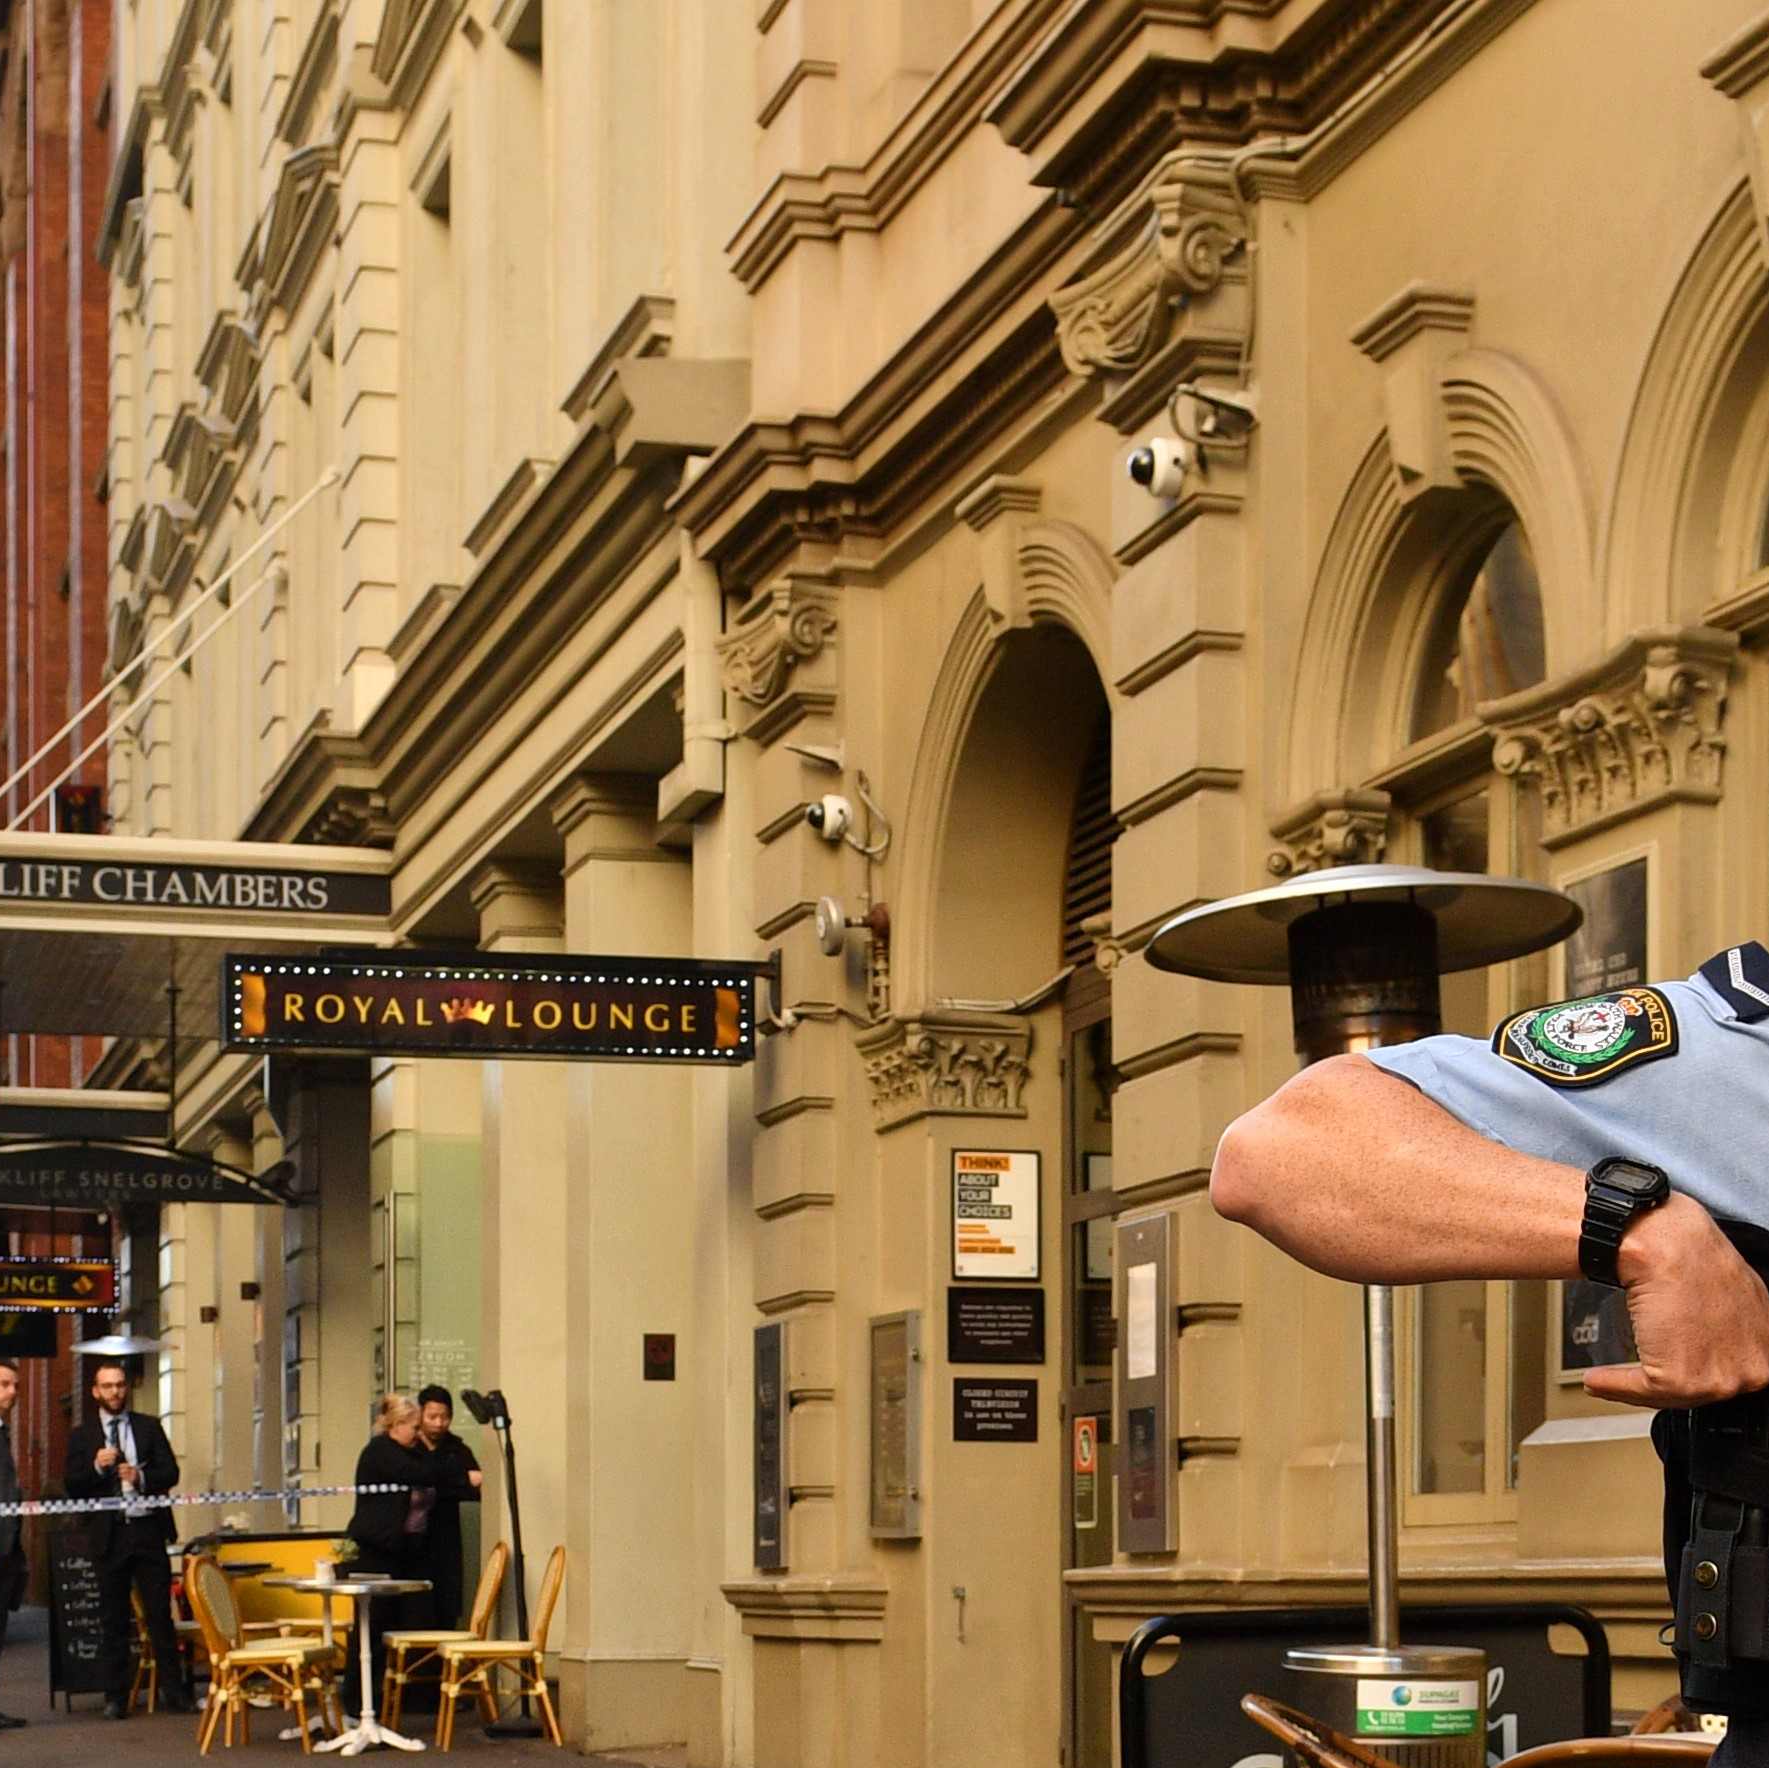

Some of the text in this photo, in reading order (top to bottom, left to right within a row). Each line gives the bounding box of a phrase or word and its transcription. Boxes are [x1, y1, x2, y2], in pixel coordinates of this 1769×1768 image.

[92, 867, 329, 909] CHAMBERS
[285, 993, 697, 1033] ROYAL LOUNGE
[1639, 995, 1665, 1041] POLICE
[79, 1169, 224, 1191] SNELGROVE
[960, 1174, 997, 1185] ABOUT
[960, 1191, 990, 1201] YOUR
[959, 1206, 1010, 1217] CHOICES
